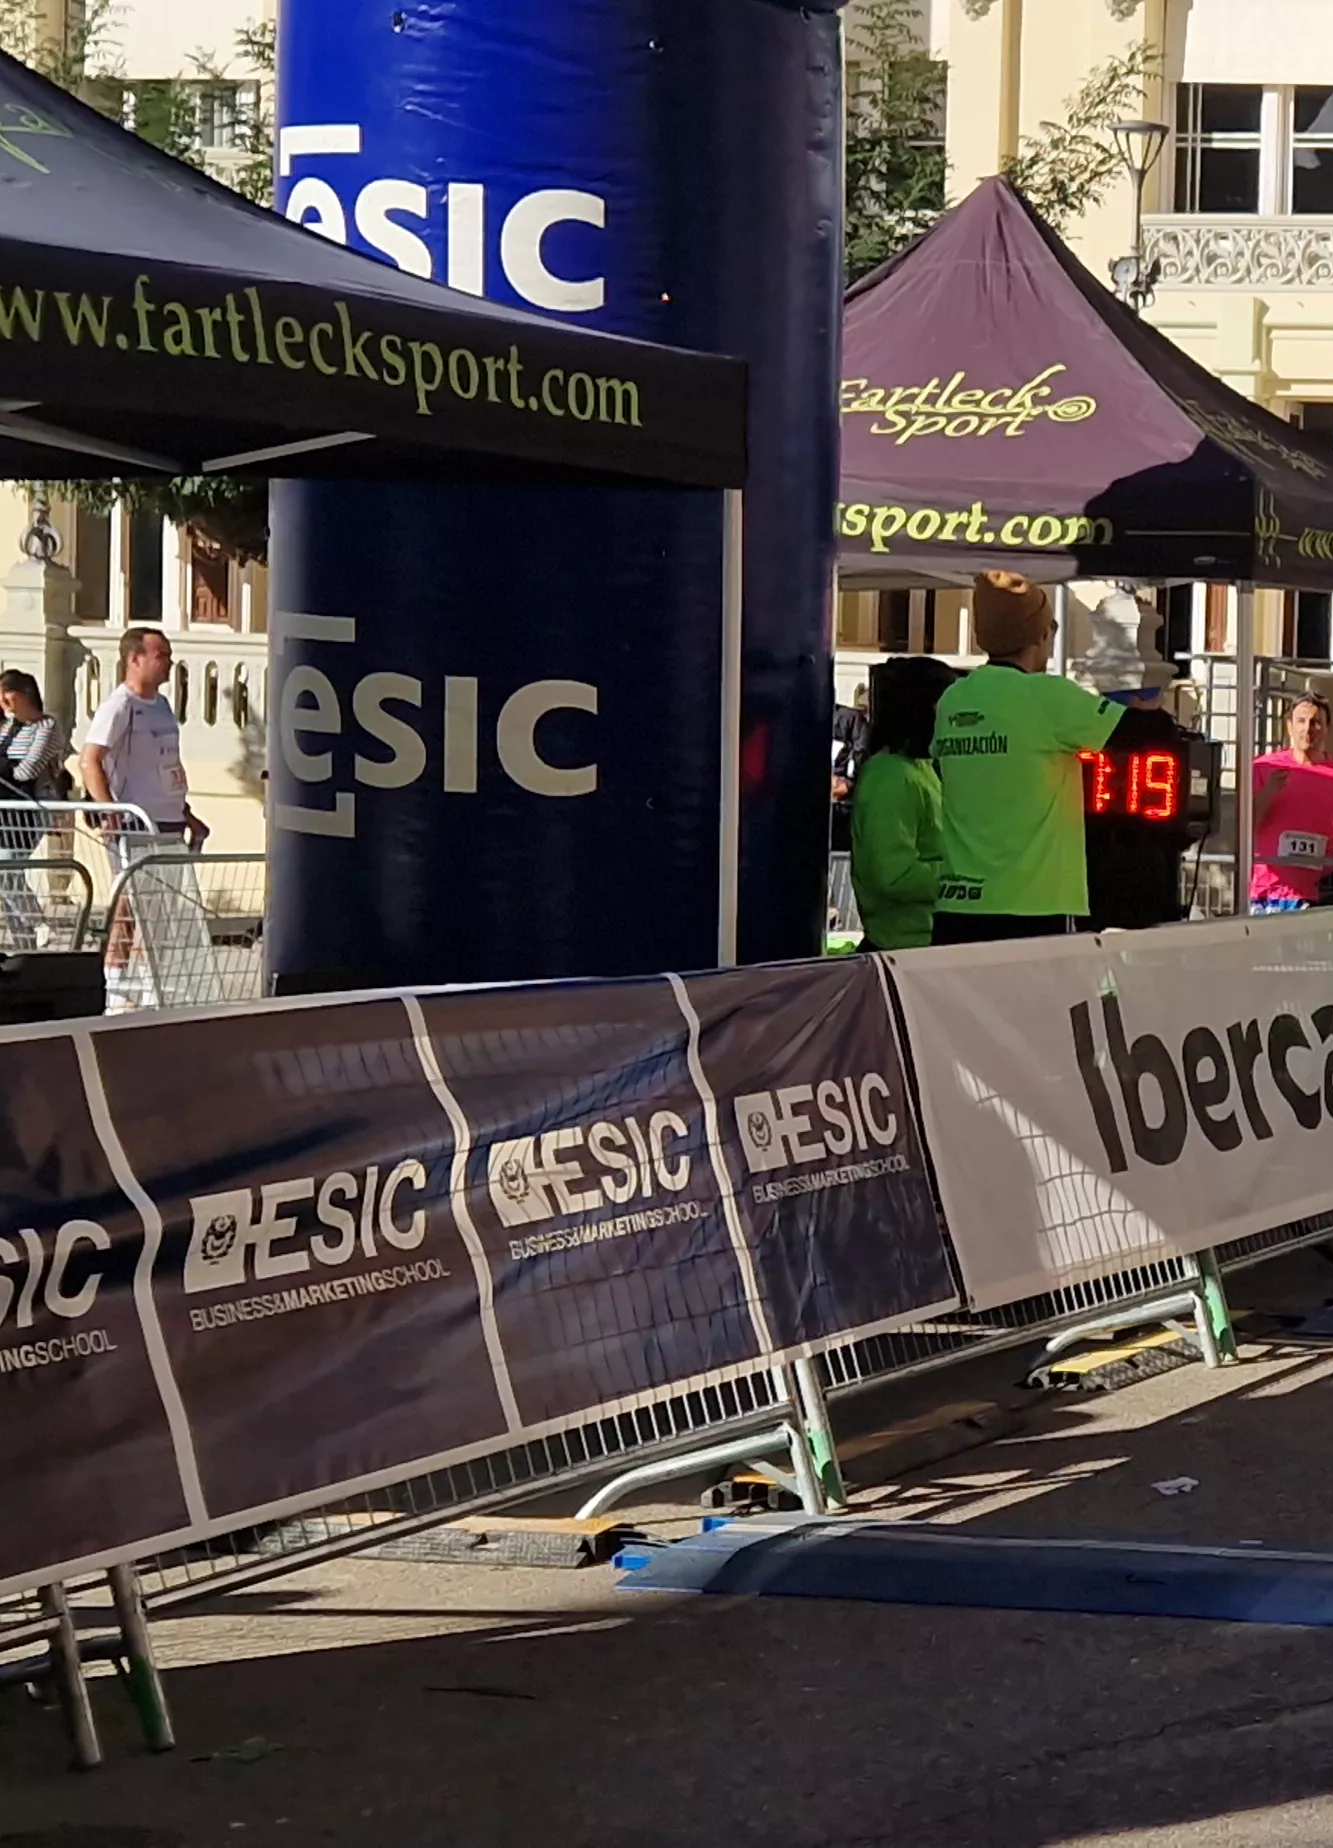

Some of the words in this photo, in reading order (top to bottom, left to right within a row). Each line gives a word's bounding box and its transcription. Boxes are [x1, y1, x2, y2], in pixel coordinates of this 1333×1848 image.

[840, 364, 1067, 413] Fartleck
[870, 404, 1034, 445] Sport
[836, 502, 1114, 553] sport.com
[1290, 840, 1315, 854] 131
[777, 1072, 898, 1164] ESIC
[541, 1110, 690, 1214] ESIC
[253, 1159, 427, 1280] ESIC
